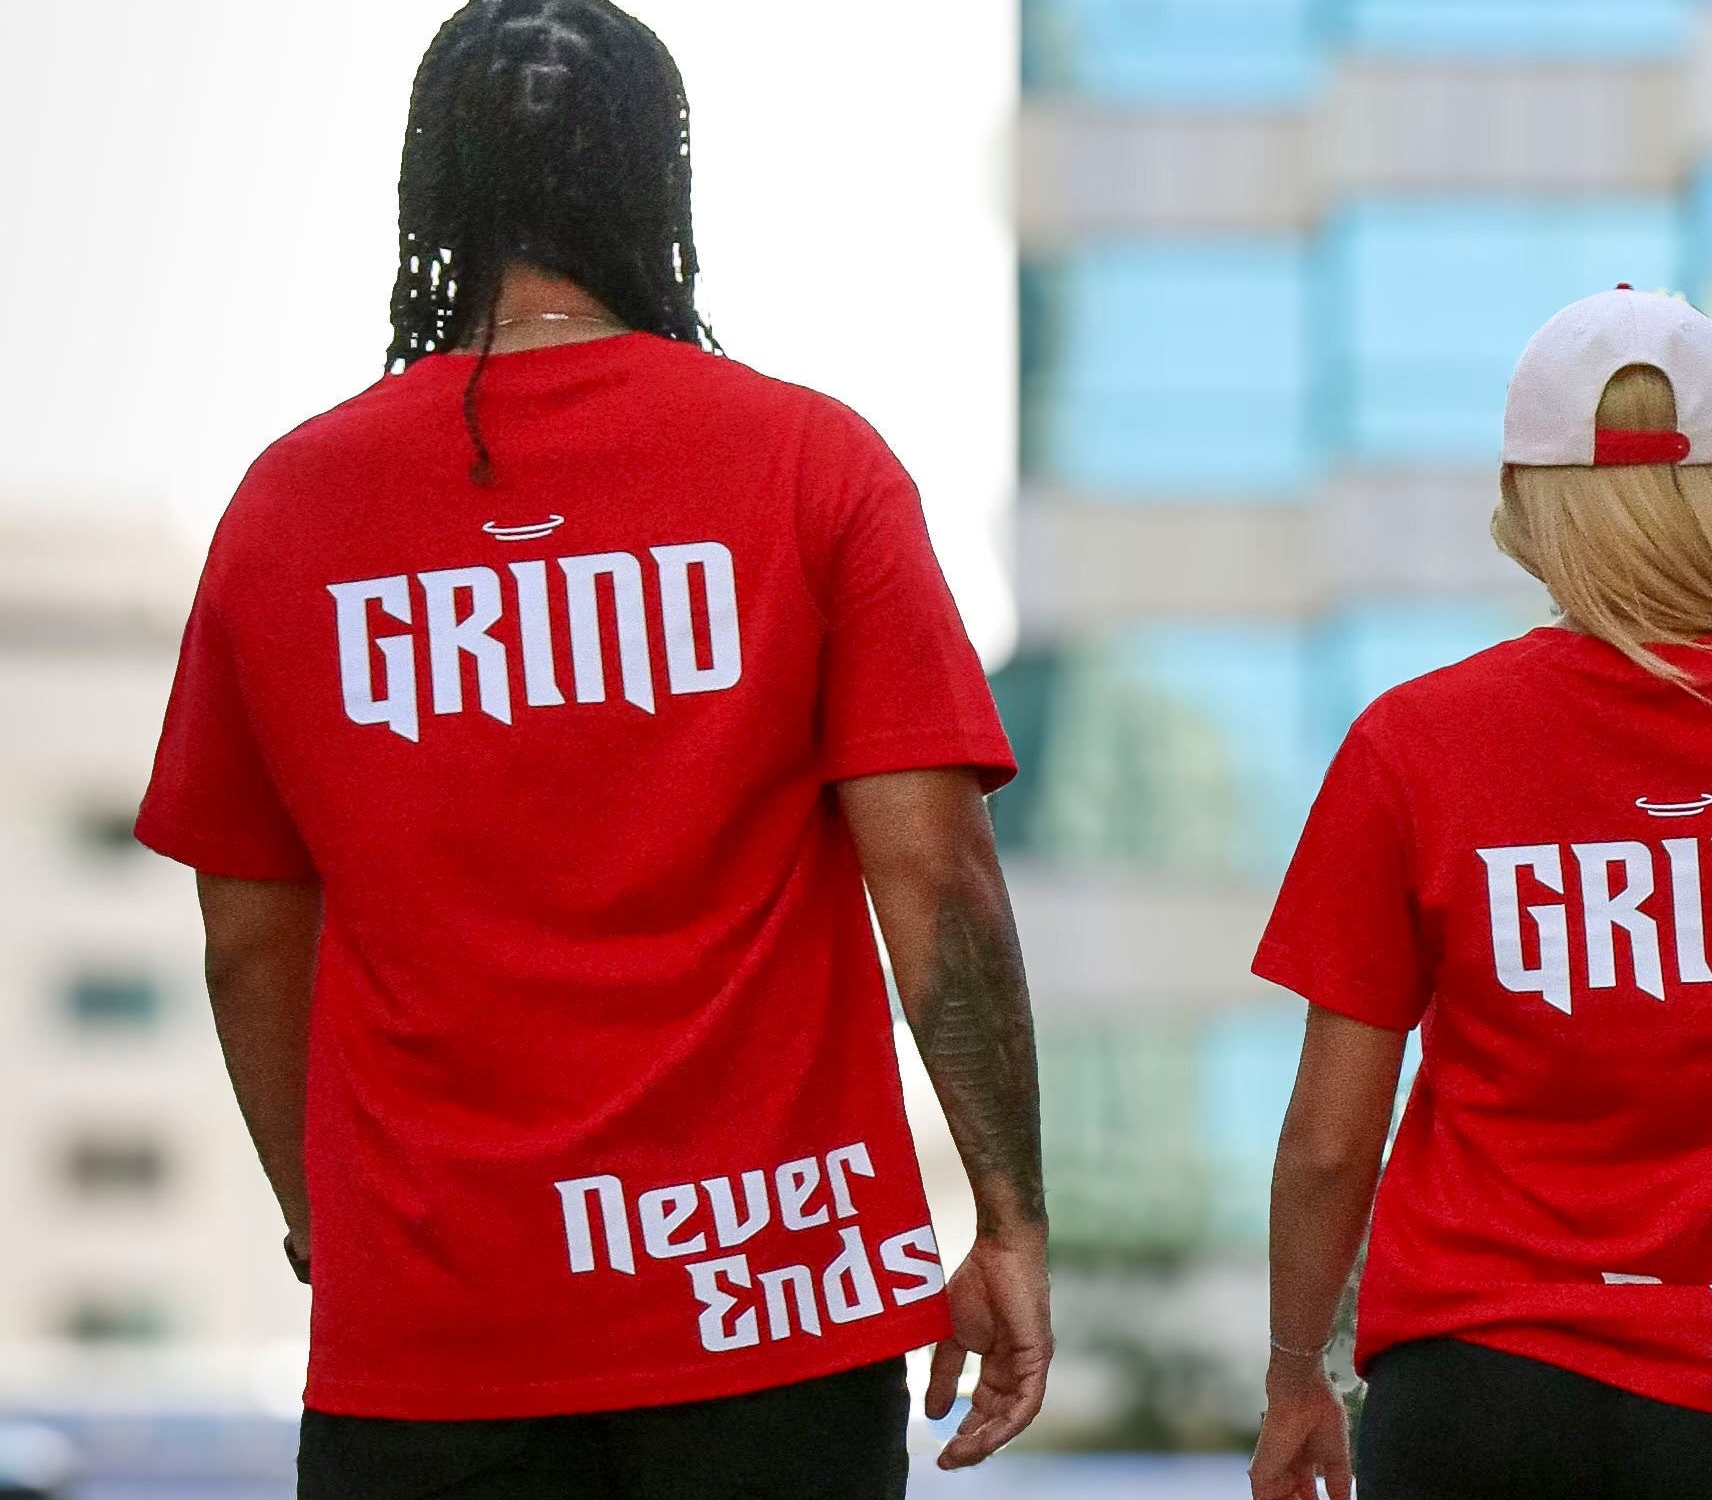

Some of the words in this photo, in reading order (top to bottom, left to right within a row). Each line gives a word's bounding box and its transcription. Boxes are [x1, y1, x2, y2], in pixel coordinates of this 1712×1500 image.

[327, 541, 742, 743] GRIND
[553, 1141, 876, 1276] Never
[684, 1223, 946, 1353] Ends
